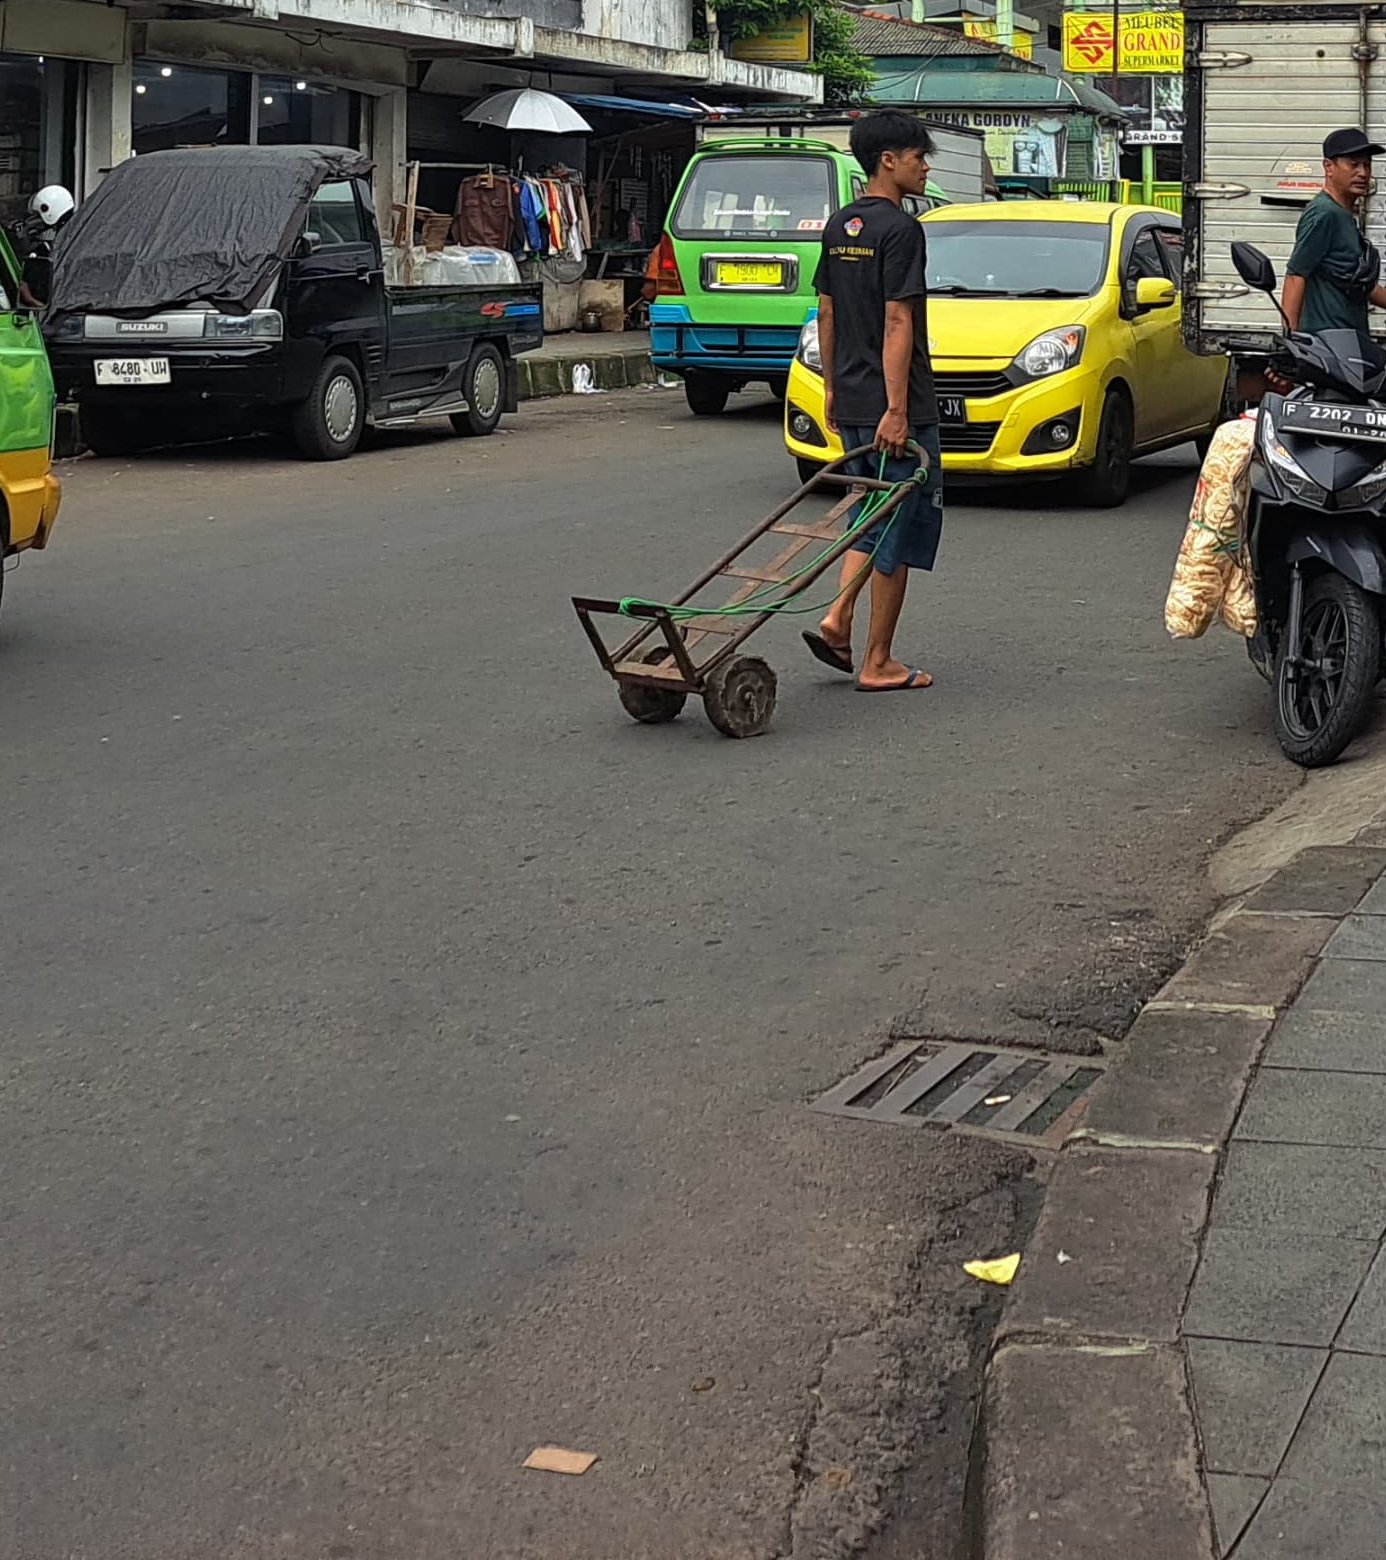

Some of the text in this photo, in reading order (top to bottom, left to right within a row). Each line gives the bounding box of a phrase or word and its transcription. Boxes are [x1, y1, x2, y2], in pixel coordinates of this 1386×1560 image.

[1124, 33, 1181, 52] GRAND
[1124, 54, 1180, 67] SUPERMARKET
[973, 112, 1030, 127] GORDYN
[120, 323, 164, 332] SUZUKI
[96, 362, 104, 377] F
[944, 398, 961, 417] JX
[1286, 404, 1296, 417] F
